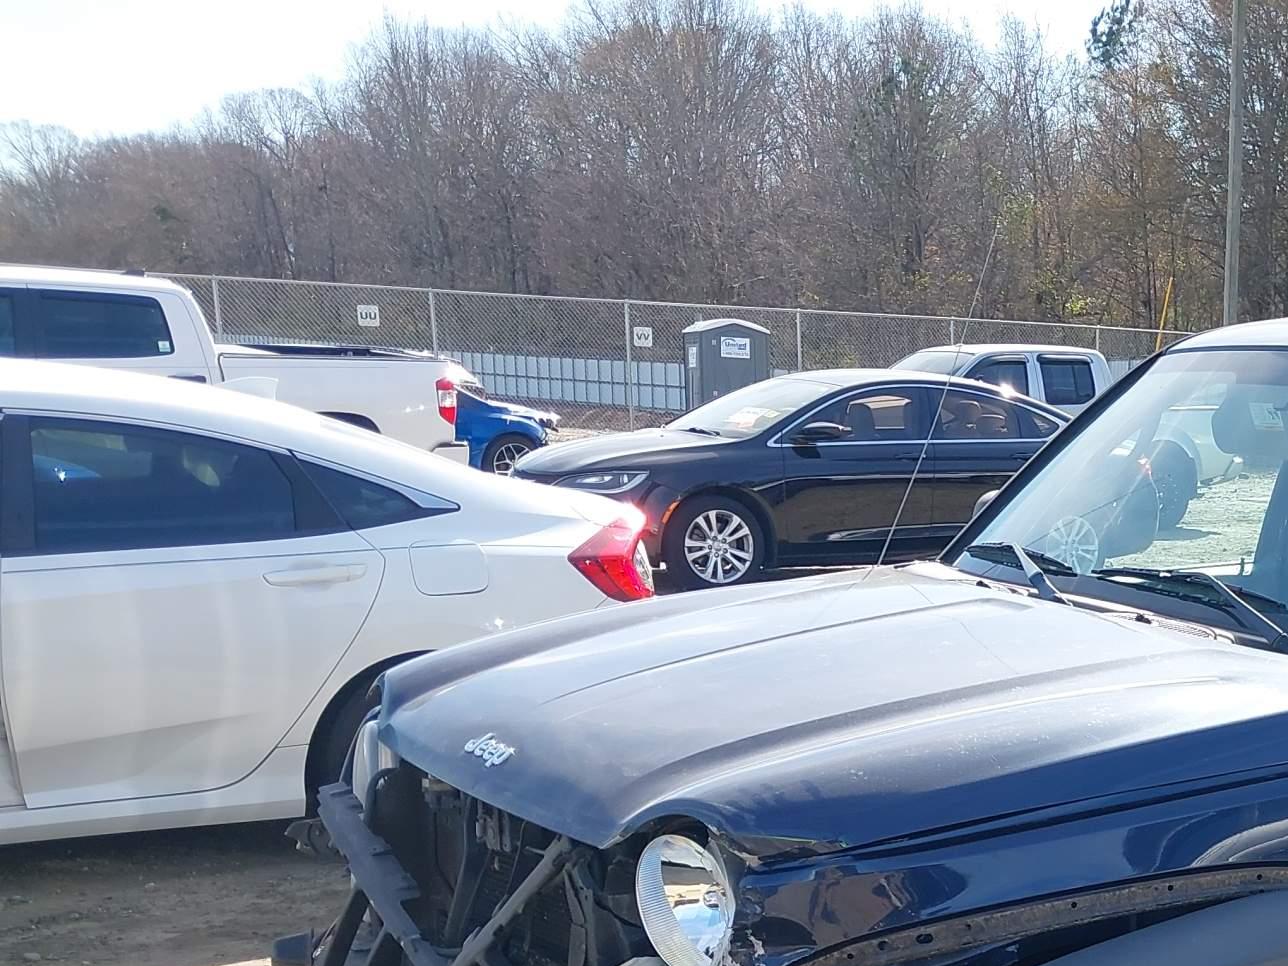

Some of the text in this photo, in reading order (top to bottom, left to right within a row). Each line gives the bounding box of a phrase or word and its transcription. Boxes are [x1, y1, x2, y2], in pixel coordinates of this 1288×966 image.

[360, 311, 377, 320] UU
[636, 332, 650, 341] VV
[464, 732, 512, 768] Jeep
